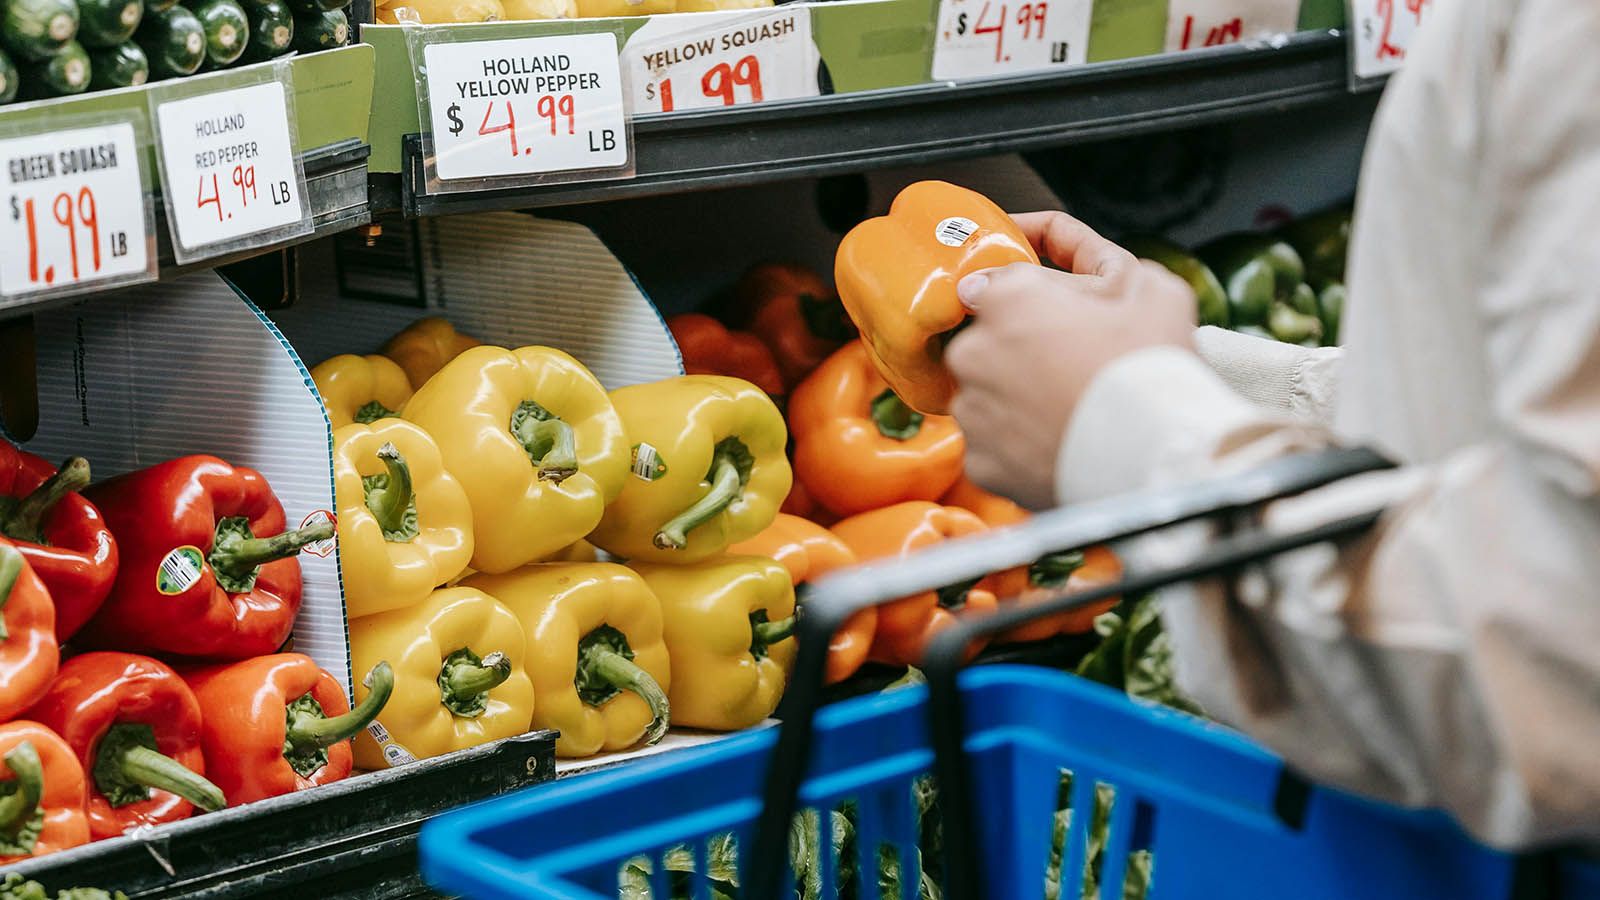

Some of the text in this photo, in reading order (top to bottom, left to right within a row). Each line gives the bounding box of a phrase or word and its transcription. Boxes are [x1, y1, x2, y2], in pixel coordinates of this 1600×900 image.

[643, 18, 795, 70] YELLOW SQUASH
[974, 2, 1048, 62] 4.99
[1051, 42, 1068, 63] LB
[456, 73, 601, 98] YELLOW PEPPER
[483, 55, 571, 76] HOLLAND
[196, 113, 245, 137] HOLLAND
[447, 95, 616, 157] $ 4.99 LB
[9, 144, 118, 183] GREEN SQUASH
[195, 142, 259, 169] RED PEPPER
[197, 165, 291, 222] 4.99 LB
[25, 186, 101, 285] 1.99
[111, 232, 128, 257] LB
